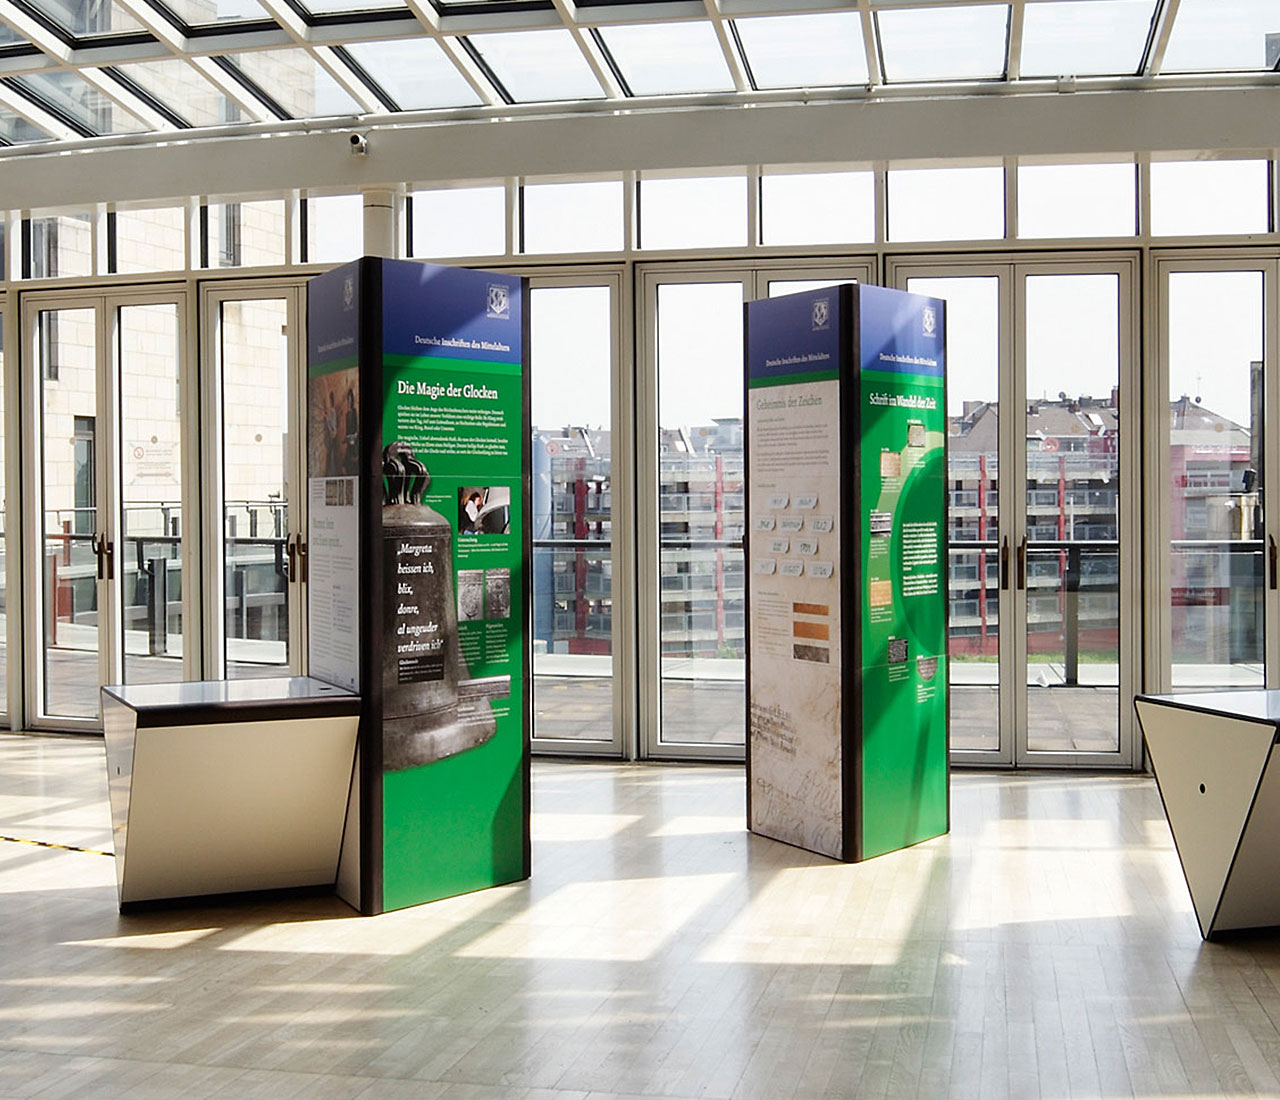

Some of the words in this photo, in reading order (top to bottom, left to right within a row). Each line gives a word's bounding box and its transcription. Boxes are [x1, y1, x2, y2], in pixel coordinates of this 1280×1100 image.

[415, 335, 441, 346] Deutsche
[441, 337, 471, 349] Inschriften
[472, 340, 481, 349] des
[481, 340, 510, 352] Mittelalters
[397, 380, 414, 395] Die
[417, 382, 445, 400] Magie
[447, 383, 462, 398] der
[463, 384, 498, 400] Glocken
[788, 397, 797, 409] der
[798, 394, 822, 407] Zeichen
[870, 392, 888, 406] Schrift
[896, 394, 917, 408] Wandel
[926, 397, 937, 410] Zeit
